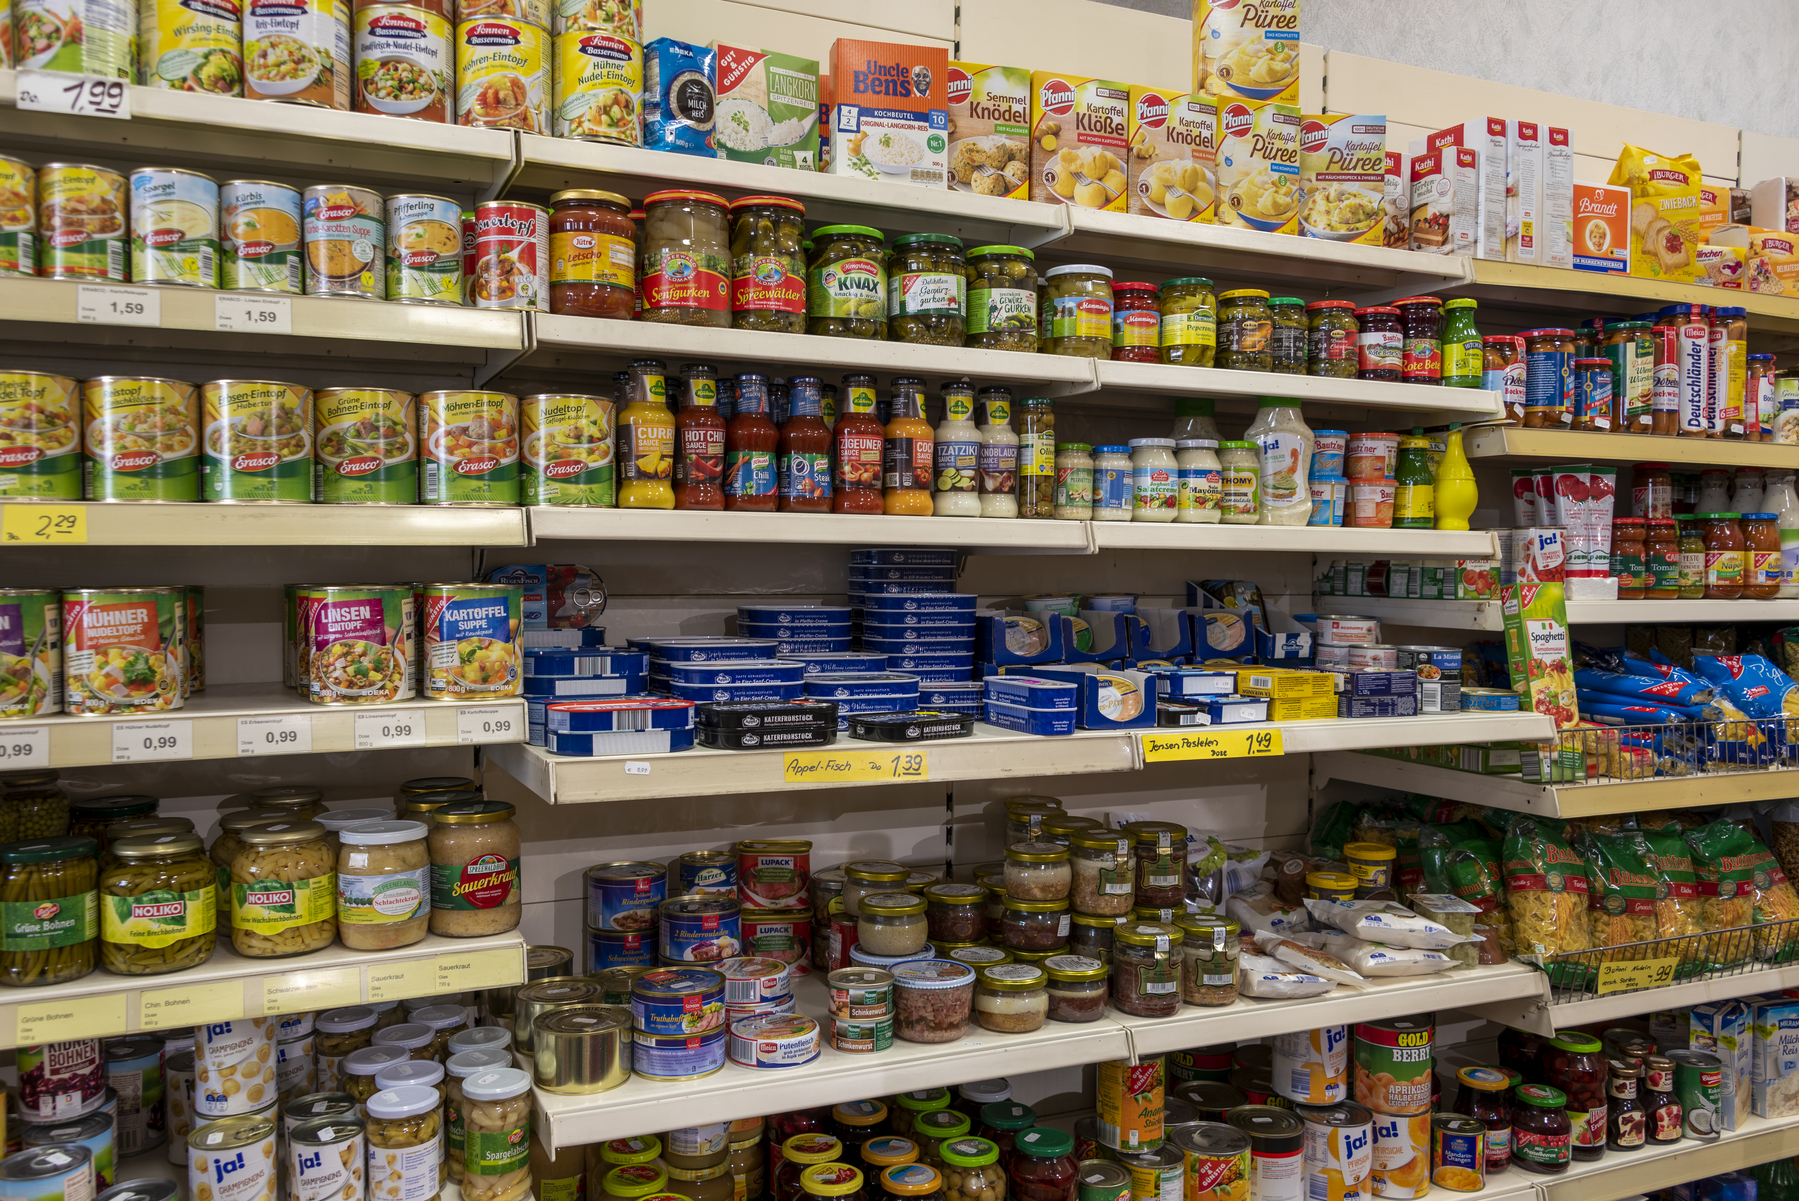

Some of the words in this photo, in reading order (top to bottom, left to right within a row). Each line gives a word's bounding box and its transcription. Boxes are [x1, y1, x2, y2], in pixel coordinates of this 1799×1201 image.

[1240, 4, 1298, 29] Püree
[374, 27, 423, 39] Bassermann
[470, 35, 515, 46] Bassermann
[585, 46, 629, 61] Bassermann
[669, 47, 694, 58] EDEKA
[719, 50, 737, 67] GUT
[461, 52, 529, 73] Möhren-Eintopf
[593, 60, 625, 73] Hühner
[867, 60, 909, 78] Uncle
[723, 55, 755, 87] GÜNSTIG
[578, 70, 636, 89] Nudel-Eintopf
[853, 71, 911, 97] Ben's
[769, 74, 816, 100] LANGKORN
[770, 94, 814, 109] SPITZENREIS
[986, 92, 1027, 105] Semmel
[1040, 86, 1076, 104] Pfanni
[874, 110, 914, 120] KOCHBEUTEL
[970, 101, 1028, 124] Knödel
[1086, 102, 1124, 117] Kartoffel
[1136, 100, 1169, 118] Pfanni
[860, 120, 928, 132] ORIGINAL-LANGKORN-REIS
[932, 115, 945, 125] 10
[1179, 116, 1213, 131] Kartoffel
[1222, 112, 1254, 128] Pfanni
[1167, 126, 1214, 150] Knödel
[1266, 128, 1298, 143] Kartoffel
[1435, 134, 1454, 148] Kathi
[1249, 133, 1298, 164] Püree
[1345, 140, 1382, 151] Kartoffel
[1325, 147, 1383, 172] Püree
[1415, 158, 1434, 172] Kathi
[235, 192, 263, 204] Kürbis
[1659, 196, 1698, 211] ZWIEBACK
[320, 207, 355, 220] Erasco
[1578, 198, 1618, 218] Brandt
[405, 252, 438, 265] Erasco
[836, 277, 881, 294] KNAX
[651, 286, 710, 303] Senfgurken
[736, 287, 801, 307] Spreewälder
[999, 296, 1024, 306] GEWÜRZ
[110, 302, 144, 315] 1,59
[1004, 304, 1032, 313] GURKEN
[245, 310, 277, 323] 1,59
[1686, 328, 1706, 337] Meica
[1688, 340, 1705, 428] Deutschländer
[338, 396, 361, 406] Grüne
[442, 398, 505, 413] Möhren-Eintopf
[327, 400, 393, 417] Bohnen-Eintopf
[540, 403, 586, 418] Nudeltopf
[685, 430, 704, 441] HOT
[707, 430, 725, 443] CHIL
[686, 441, 707, 449] SAUCE
[840, 438, 882, 450] ZIGEUNER
[937, 445, 978, 457] TZATZIKI
[1263, 439, 1279, 452] ja!
[841, 449, 860, 457] SAUCE
[938, 456, 956, 464] SAUCE
[980, 447, 1017, 459] KNOBLAUCH
[112, 454, 158, 468] Erasco
[235, 455, 279, 469] Erasco
[340, 459, 383, 473] Erasco
[459, 459, 498, 472] Erasco
[980, 457, 998, 465] SAUCE
[547, 463, 585, 477] Erasco
[753, 470, 770, 480] Chili
[814, 473, 831, 482] Steak
[1222, 477, 1252, 485] THOMY
[1136, 486, 1177, 494] Salatcreme
[1538, 530, 1558, 551] ja!
[83, 609, 149, 628] HÜHNER
[321, 606, 371, 624] LINSEN
[445, 605, 507, 622] KARTOFFEL
[328, 620, 363, 632] EINTOPF
[458, 619, 488, 630] SUPPE
[1531, 631, 1565, 643] Spaghetti
[362, 688, 390, 697] EDEKA
[490, 684, 513, 692] EDEKA
[382, 725, 412, 739] 0,99
[483, 720, 511, 735] 0,99
[143, 736, 177, 751] 0,99
[266, 731, 297, 745] 0,99
[1149, 741, 1180, 753] Jensen
[1181, 737, 1219, 749] Pasteten
[786, 758, 852, 775] Appel-Fisch
[452, 866, 518, 897] Sauerkraut
[697, 871, 723, 883] Harzer
[381, 878, 414, 891] PEENELAND
[248, 891, 291, 905] NOLIKO
[134, 903, 183, 917] NOLIKO
[15, 922, 41, 934] Grüne
[43, 918, 76, 931] Bohnen
[252, 914, 303, 925] Wachsbrechbohnen
[130, 929, 146, 938] Feine
[147, 926, 186, 937] Brechbohnen
[679, 929, 729, 939] Rinderrouladen
[438, 963, 471, 972] Sauerkraut
[371, 973, 405, 982] Sauerkraut
[763, 980, 777, 989] Meica
[145, 1001, 162, 1009] Chin.
[164, 997, 190, 1007] Bohnen
[21, 1014, 45, 1024] Grüne
[47, 1010, 73, 1021] Bohnen
[851, 1006, 887, 1017] Schinkenwurst
[206, 1021, 232, 1044] ja!
[1326, 1025, 1345, 1053] ja!
[1397, 1031, 1429, 1047] GOLD
[208, 1037, 254, 1056] CHAMPIGNONS
[760, 1043, 777, 1053] Meica
[779, 1036, 814, 1050] Putenfleisch
[837, 1040, 873, 1051] Schinkenwurst
[1782, 1043, 1798, 1057] Reis
[50, 1046, 96, 1068] BOHNEN
[1392, 1045, 1431, 1062] BERRY
[1372, 1121, 1399, 1144] ja!
[1345, 1129, 1368, 1159] ja!
[1373, 1146, 1404, 1155] PFIRSICHE
[298, 1151, 322, 1176] ja!
[1446, 1156, 1472, 1165] Orangen
[214, 1152, 245, 1184] ja!
[1200, 1161, 1213, 1175] GUT
[1202, 1163, 1227, 1187] GÜNSTIG
[218, 1170, 265, 1195] CHAMPIGNONS
[301, 1170, 342, 1187] CHAMPIGNONS
